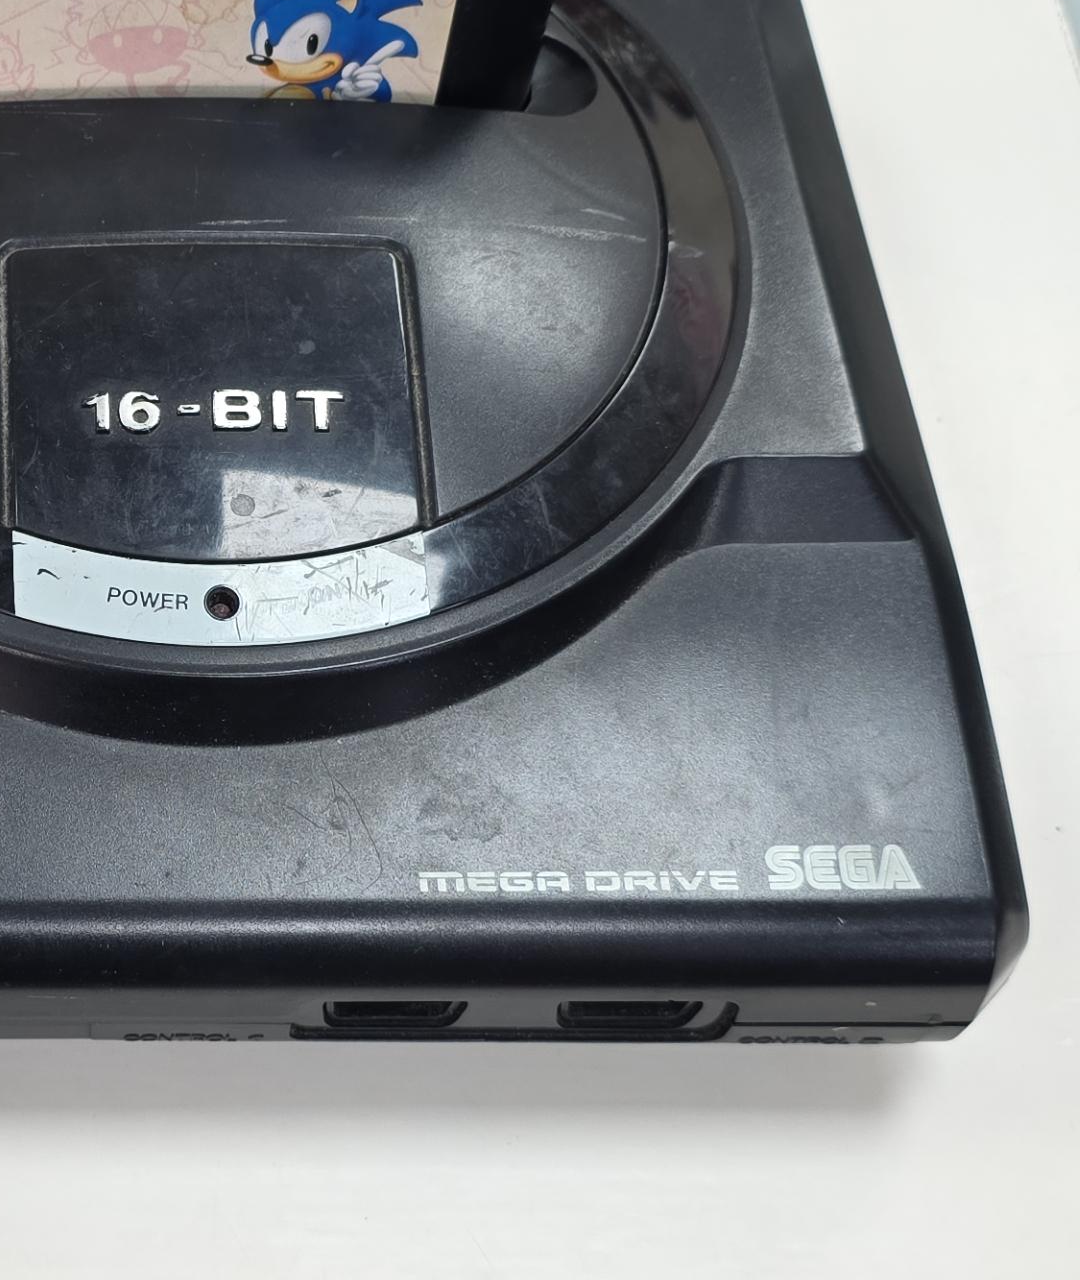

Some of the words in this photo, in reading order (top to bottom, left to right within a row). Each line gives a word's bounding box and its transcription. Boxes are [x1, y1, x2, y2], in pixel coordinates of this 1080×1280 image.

[106, 585, 190, 611] POWER
[419, 870, 572, 893] MEGA
[584, 869, 741, 893] DRIVE
[764, 843, 923, 891] SEGA
